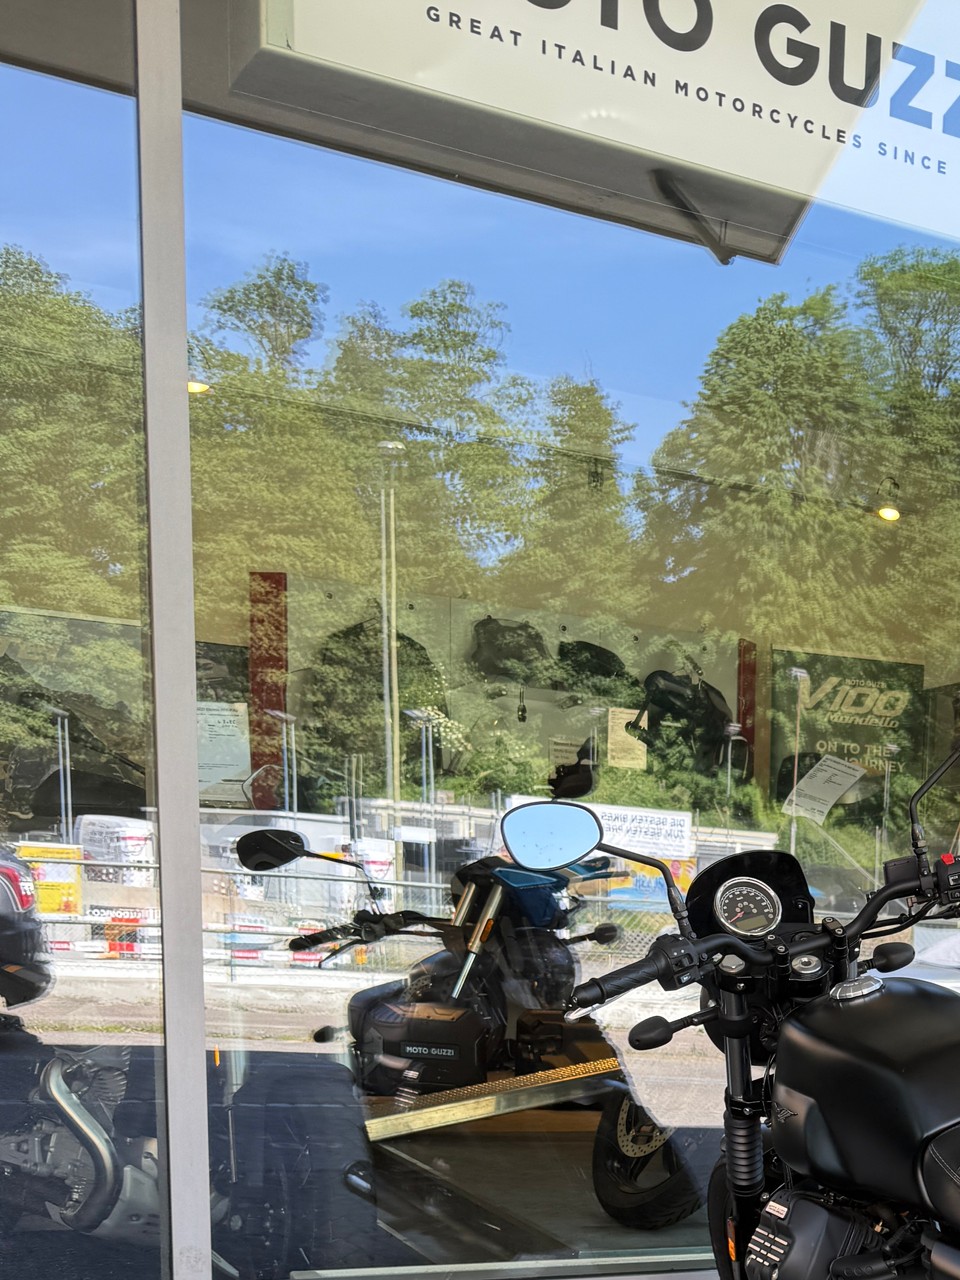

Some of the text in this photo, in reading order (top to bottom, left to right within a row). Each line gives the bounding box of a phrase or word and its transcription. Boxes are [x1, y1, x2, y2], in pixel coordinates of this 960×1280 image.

[426, 6, 522, 47] GREAT
[541, 39, 656, 87] ITALIAN
[675, 79, 862, 149] MOTORCYCLES
[878, 141, 946, 175] SINCE
[798, 676, 912, 718] V100
[816, 740, 891, 757] ON TO THE
[406, 1046, 455, 1056] MOTO GUZZI
